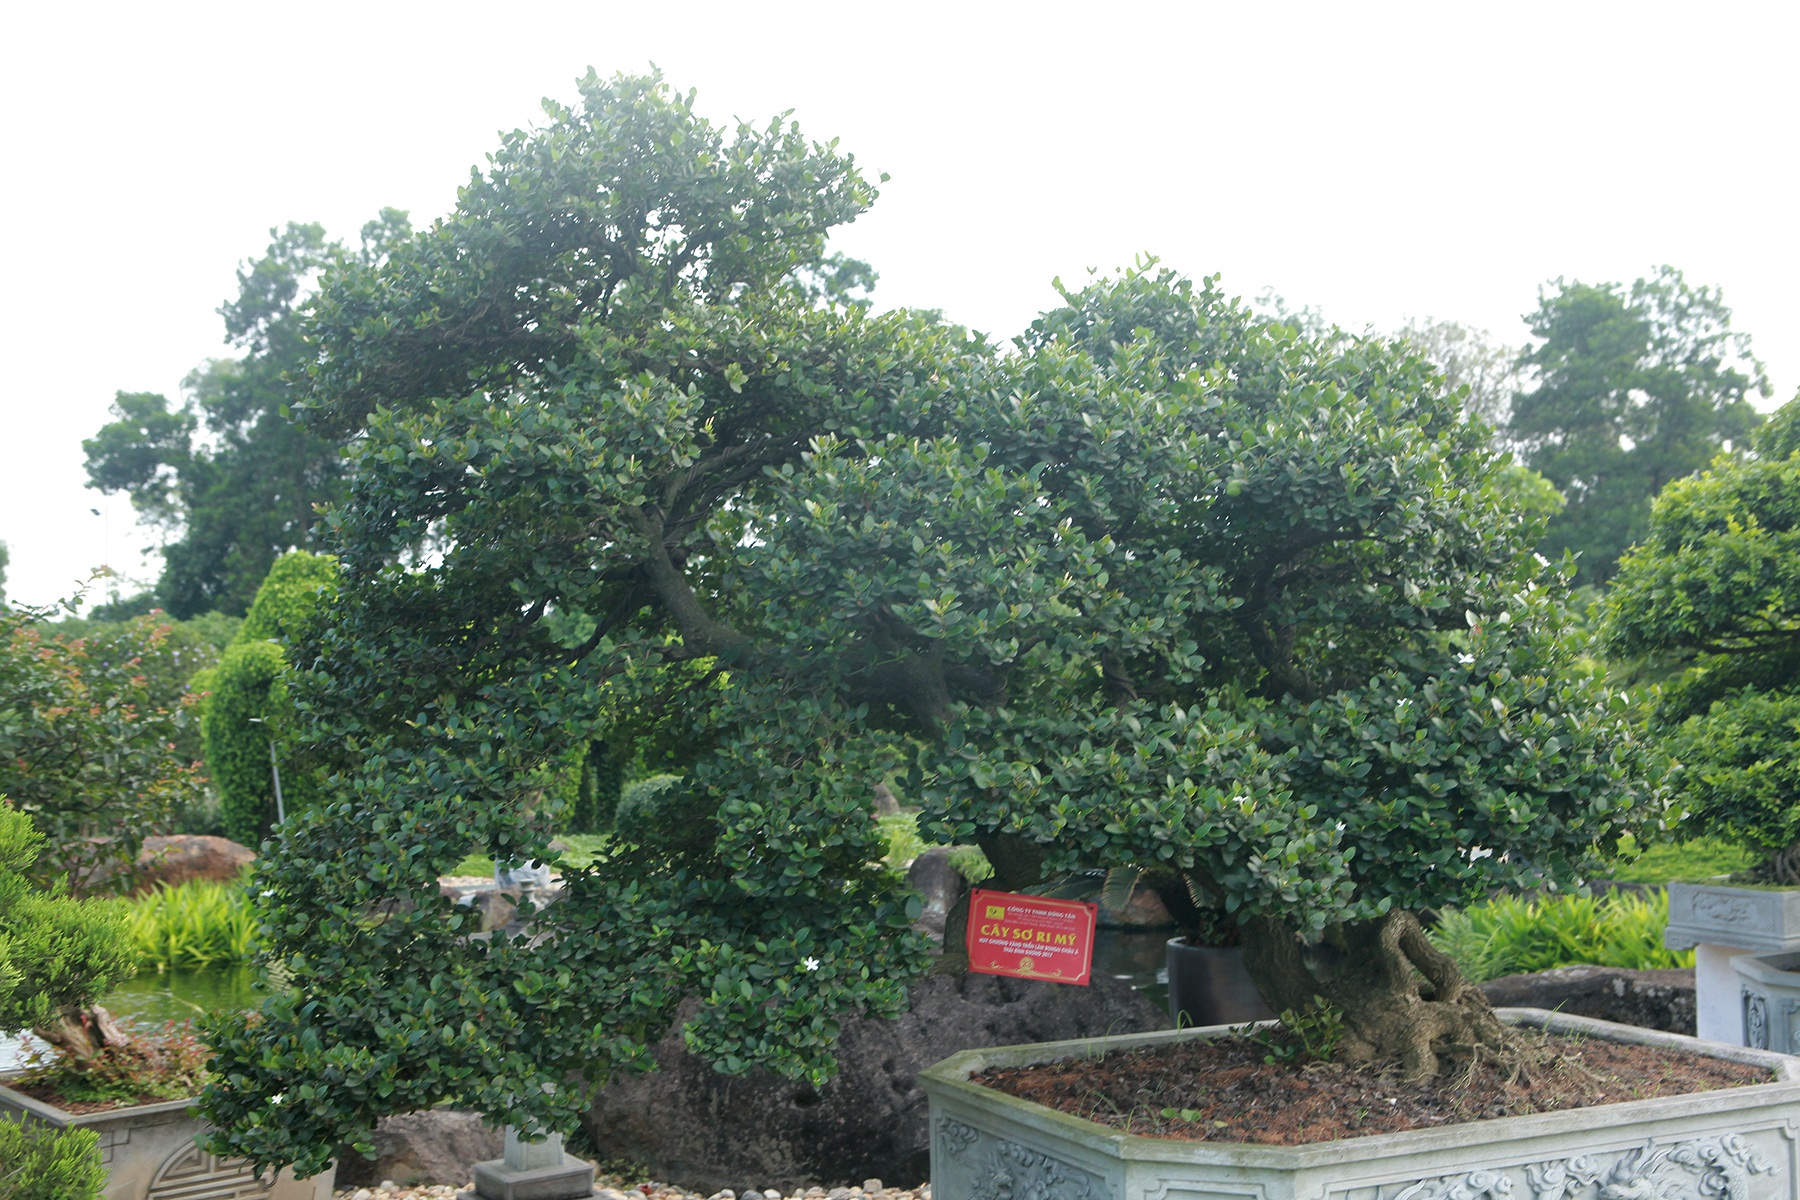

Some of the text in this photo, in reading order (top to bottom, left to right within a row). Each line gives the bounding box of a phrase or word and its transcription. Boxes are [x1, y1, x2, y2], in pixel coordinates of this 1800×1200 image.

[981, 923, 1010, 938] CÂY
[1012, 928, 1033, 941] SƠ
[1036, 931, 1051, 943] RI
[1054, 932, 1077, 946] MỸ
